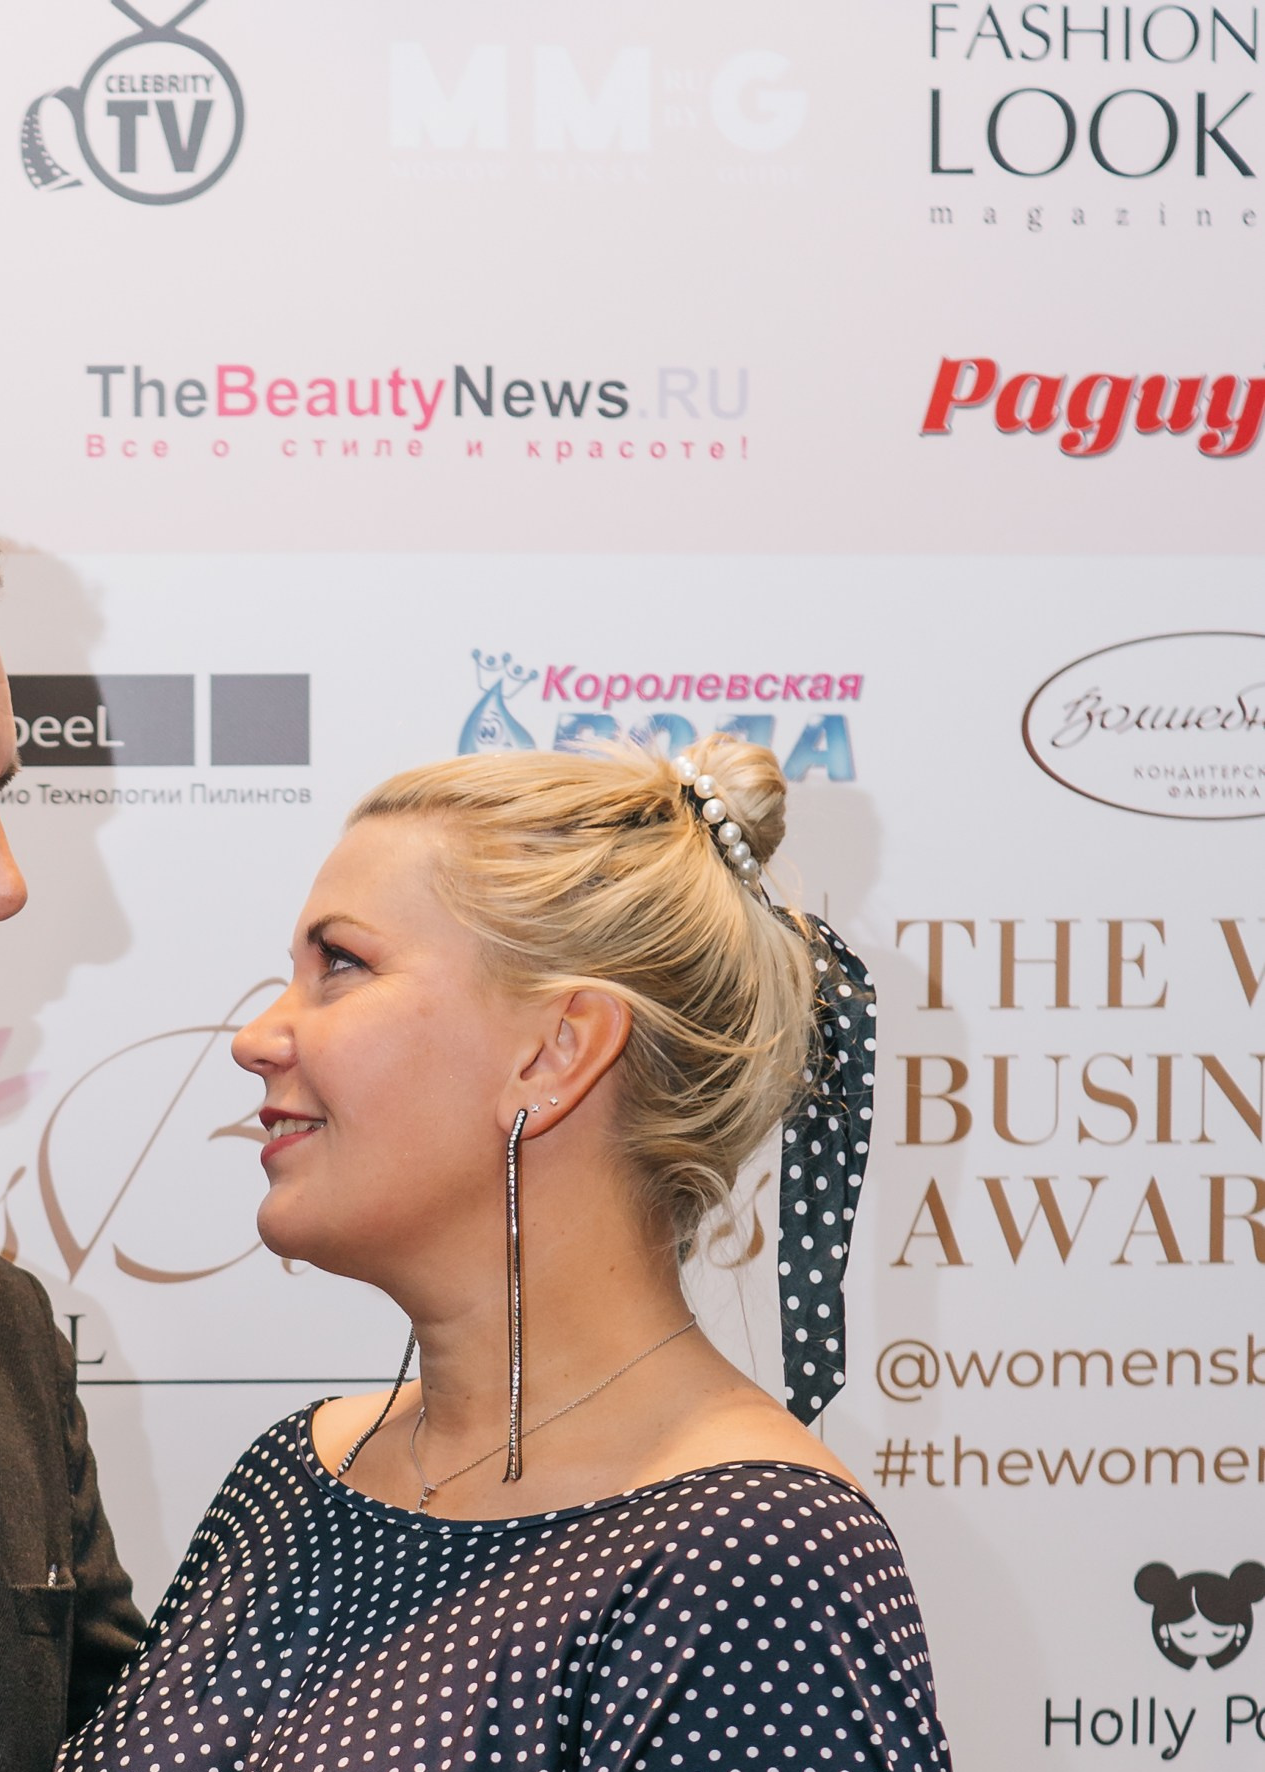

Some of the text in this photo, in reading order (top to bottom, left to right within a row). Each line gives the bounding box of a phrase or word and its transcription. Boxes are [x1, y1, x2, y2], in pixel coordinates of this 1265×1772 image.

[929, 2, 1258, 64] FASHION
[105, 74, 214, 94] CELEBRITY
[106, 99, 214, 173] TV
[930, 87, 1257, 178] LOOK
[929, 202, 1257, 233] magazine
[86, 434, 169, 459] Все
[282, 438, 424, 458] стиле
[466, 438, 484, 458] и
[528, 436, 749, 464] красоте!
[542, 664, 864, 709] Королевская
[37, 783, 182, 806] Технологии
[190, 783, 312, 805] Пилингов
[1167, 784, 1261, 800] ФАБРИКА
[895, 918, 1168, 1011] THE
[895, 1052, 1265, 1147] BUSIN
[890, 1175, 1265, 1268] AWAR
[873, 1434, 1265, 1488] #thewome
[1045, 1694, 1265, 1761] Holly P
